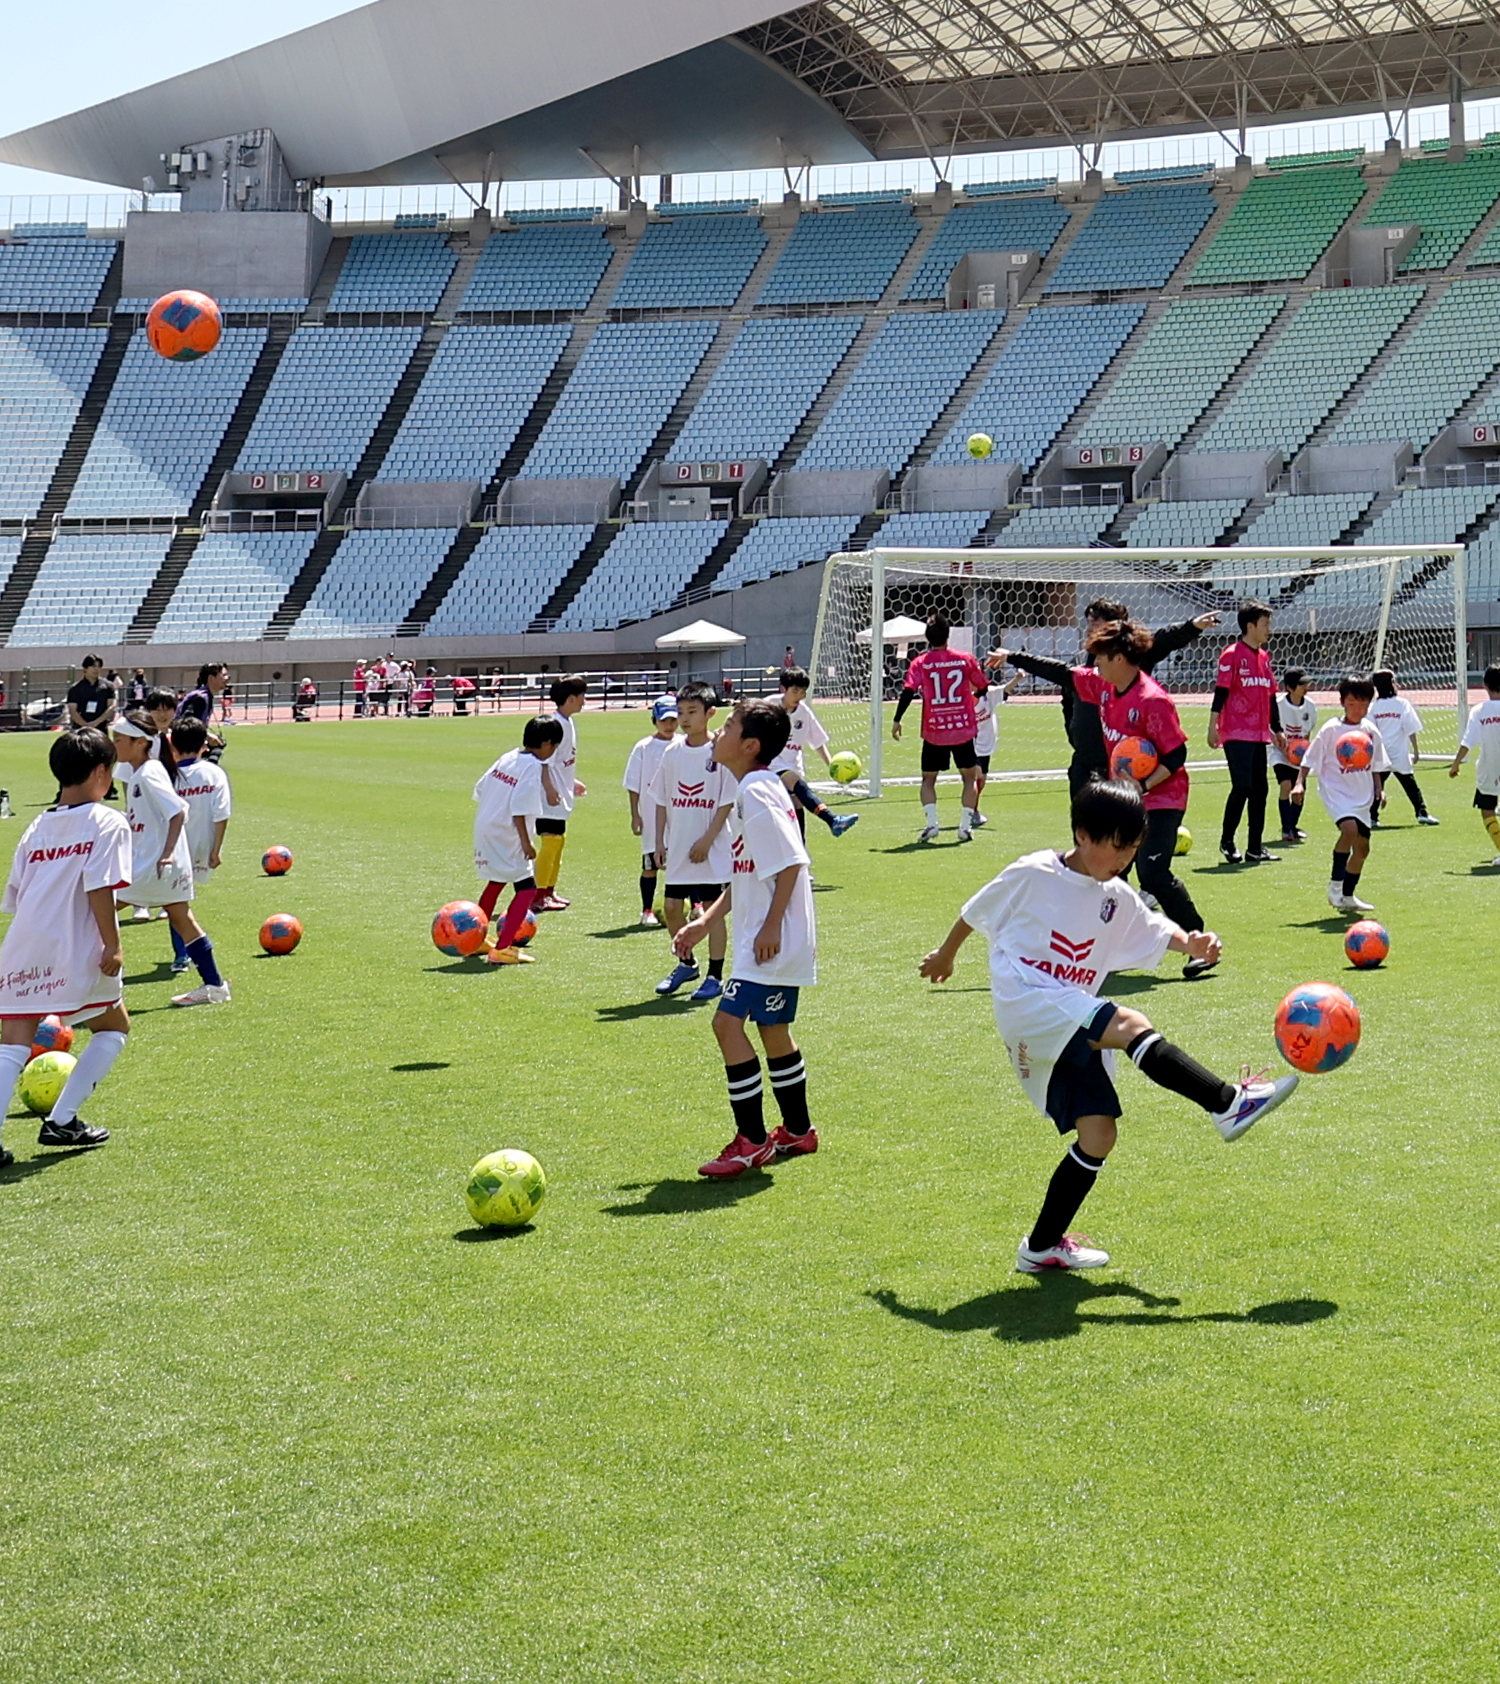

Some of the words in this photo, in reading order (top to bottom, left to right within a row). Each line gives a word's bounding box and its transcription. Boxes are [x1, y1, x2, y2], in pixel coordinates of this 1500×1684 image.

[1475, 428, 1485, 440] C
[1081, 451, 1090, 462] C
[1131, 449, 1140, 461] 3
[679, 467, 689, 479] D
[733, 465, 739, 477] 1
[252, 476, 264, 488] D
[309, 476, 319, 487] 2
[929, 669, 964, 705] 12
[33, 977, 67, 996] engine
